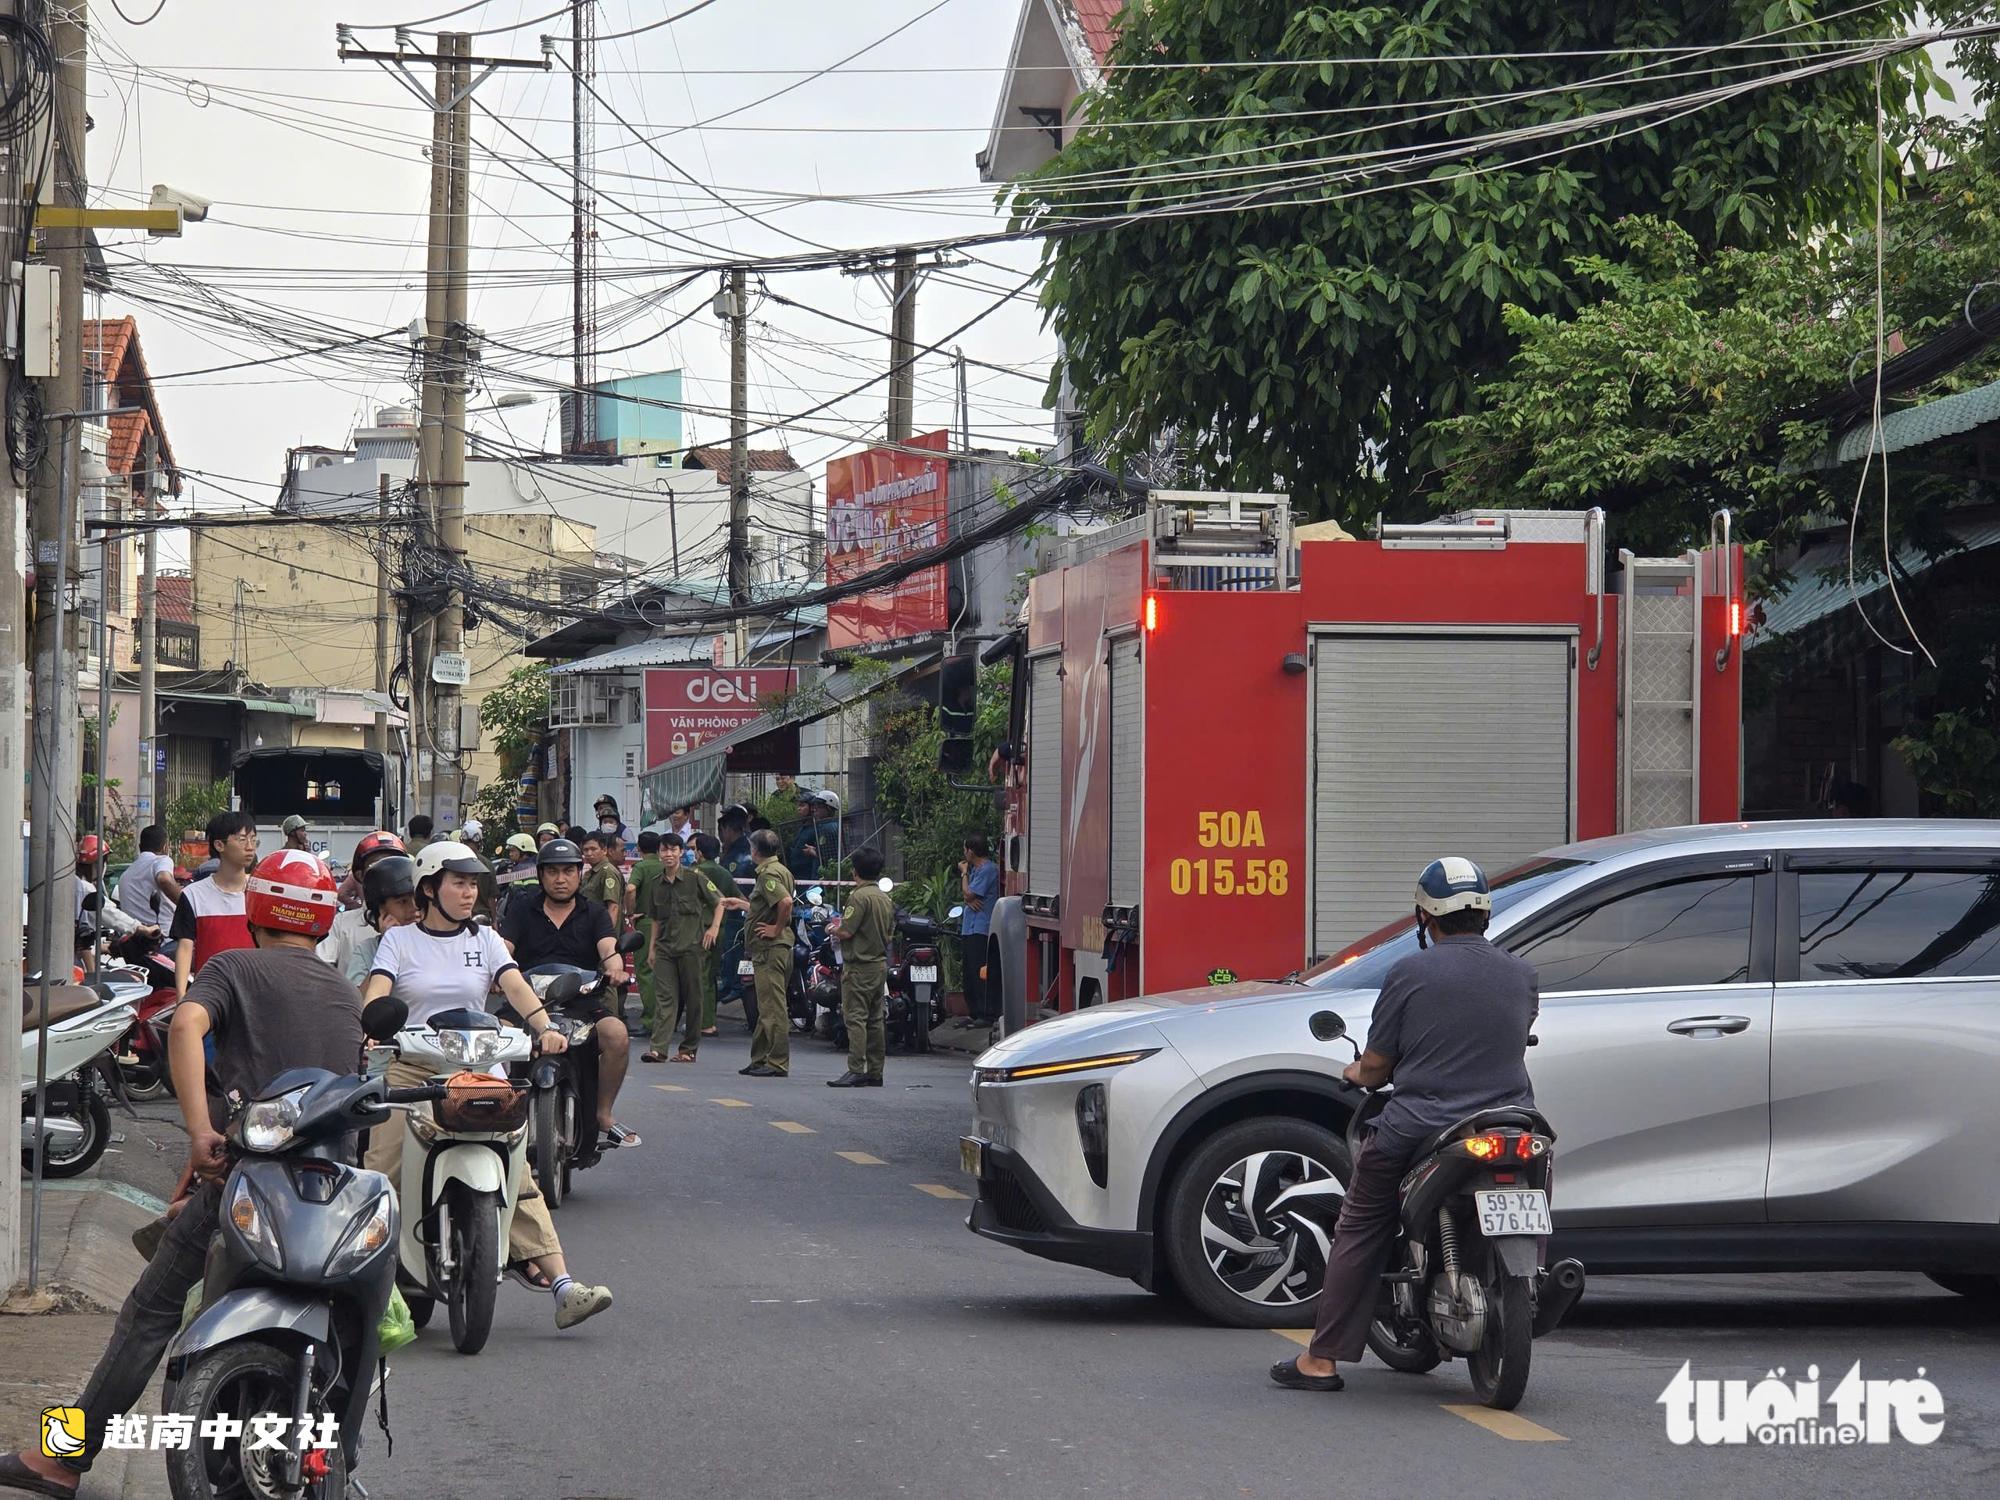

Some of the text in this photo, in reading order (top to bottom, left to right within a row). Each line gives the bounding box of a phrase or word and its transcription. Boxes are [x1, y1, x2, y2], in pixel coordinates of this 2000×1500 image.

[687, 676, 757, 703] deli
[670, 715, 695, 728] VĂN
[697, 715, 739, 728] PHÒNG
[1198, 810, 1265, 848] 50A
[1170, 858, 1289, 896] 015.58
[463, 951, 482, 967] H
[1487, 1193, 1537, 1211] 59-X2
[1484, 1213, 1546, 1232] 576.44
